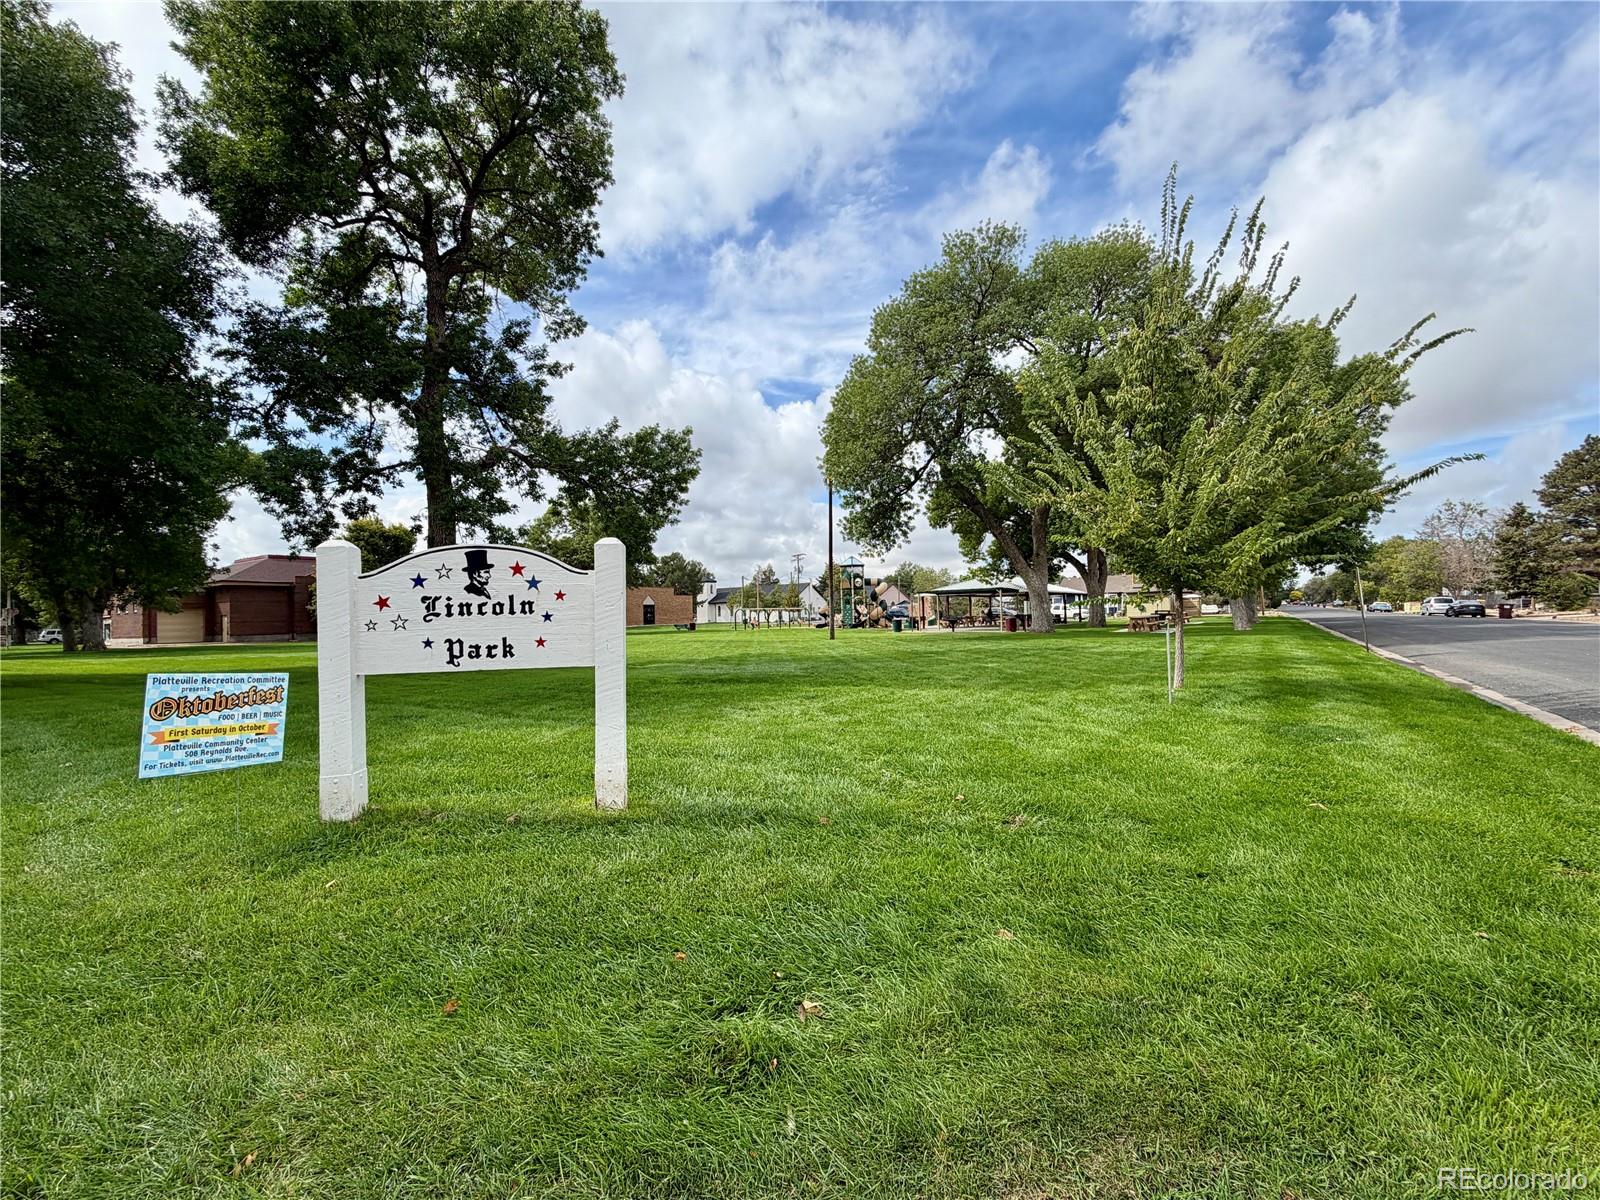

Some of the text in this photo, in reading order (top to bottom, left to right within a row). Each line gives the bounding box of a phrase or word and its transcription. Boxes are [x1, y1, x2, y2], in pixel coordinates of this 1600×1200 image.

[421, 594, 535, 622] Lincoln
[444, 636, 516, 667] Park
[152, 676, 198, 685] Platteville
[149, 685, 284, 721] Oktoberfest
[241, 712, 258, 720] BEER
[168, 728, 189, 737] First
[191, 727, 227, 735] Saturday
[238, 724, 266, 732] October
[164, 742, 203, 752] Platteville
[204, 739, 244, 748] Community
[200, 748, 232, 757] Reynolds
[205, 751, 280, 764] www.PlattevilleRec.com
